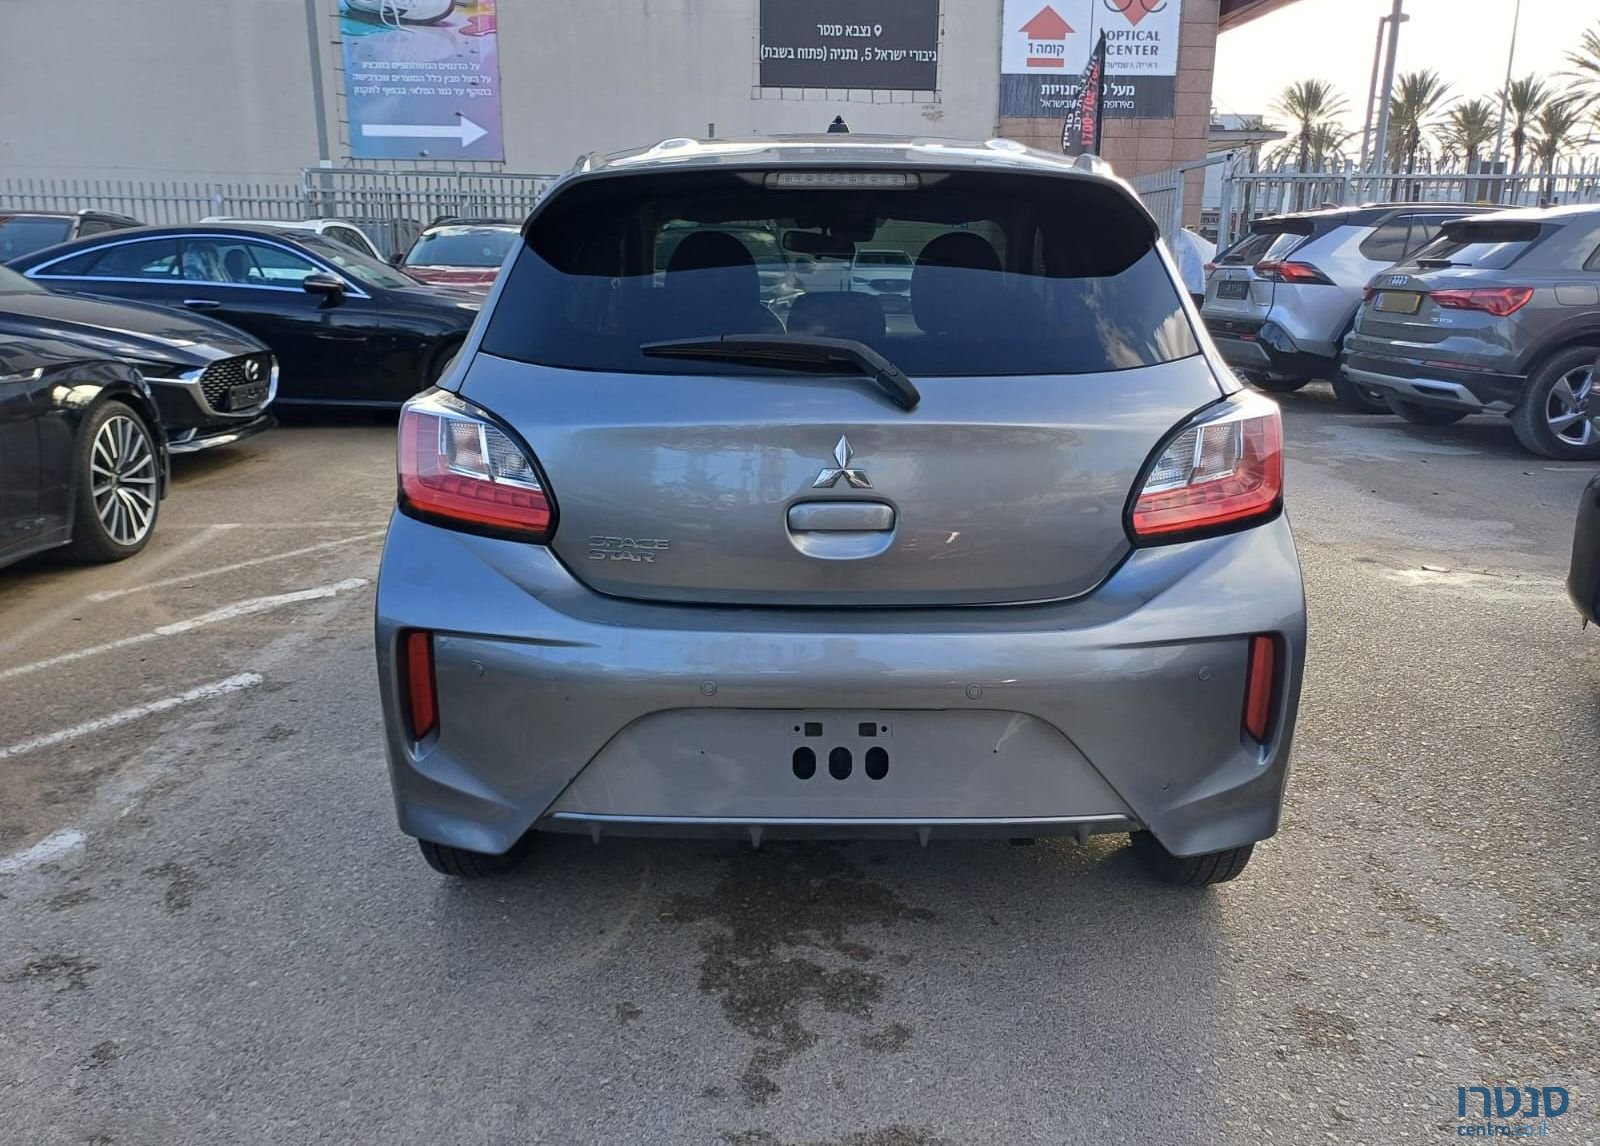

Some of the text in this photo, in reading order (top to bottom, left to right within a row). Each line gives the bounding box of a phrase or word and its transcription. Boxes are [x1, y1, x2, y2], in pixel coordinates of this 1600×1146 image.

[816, 24, 871, 37] נצבא סנטר
[1106, 30, 1160, 42] OPTICAL
[829, 48, 858, 61] נתניה
[874, 47, 906, 61] ישראל
[1036, 43, 1065, 57] קומה
[1106, 45, 1159, 56] CENTER
[1110, 83, 1135, 96] מעל
